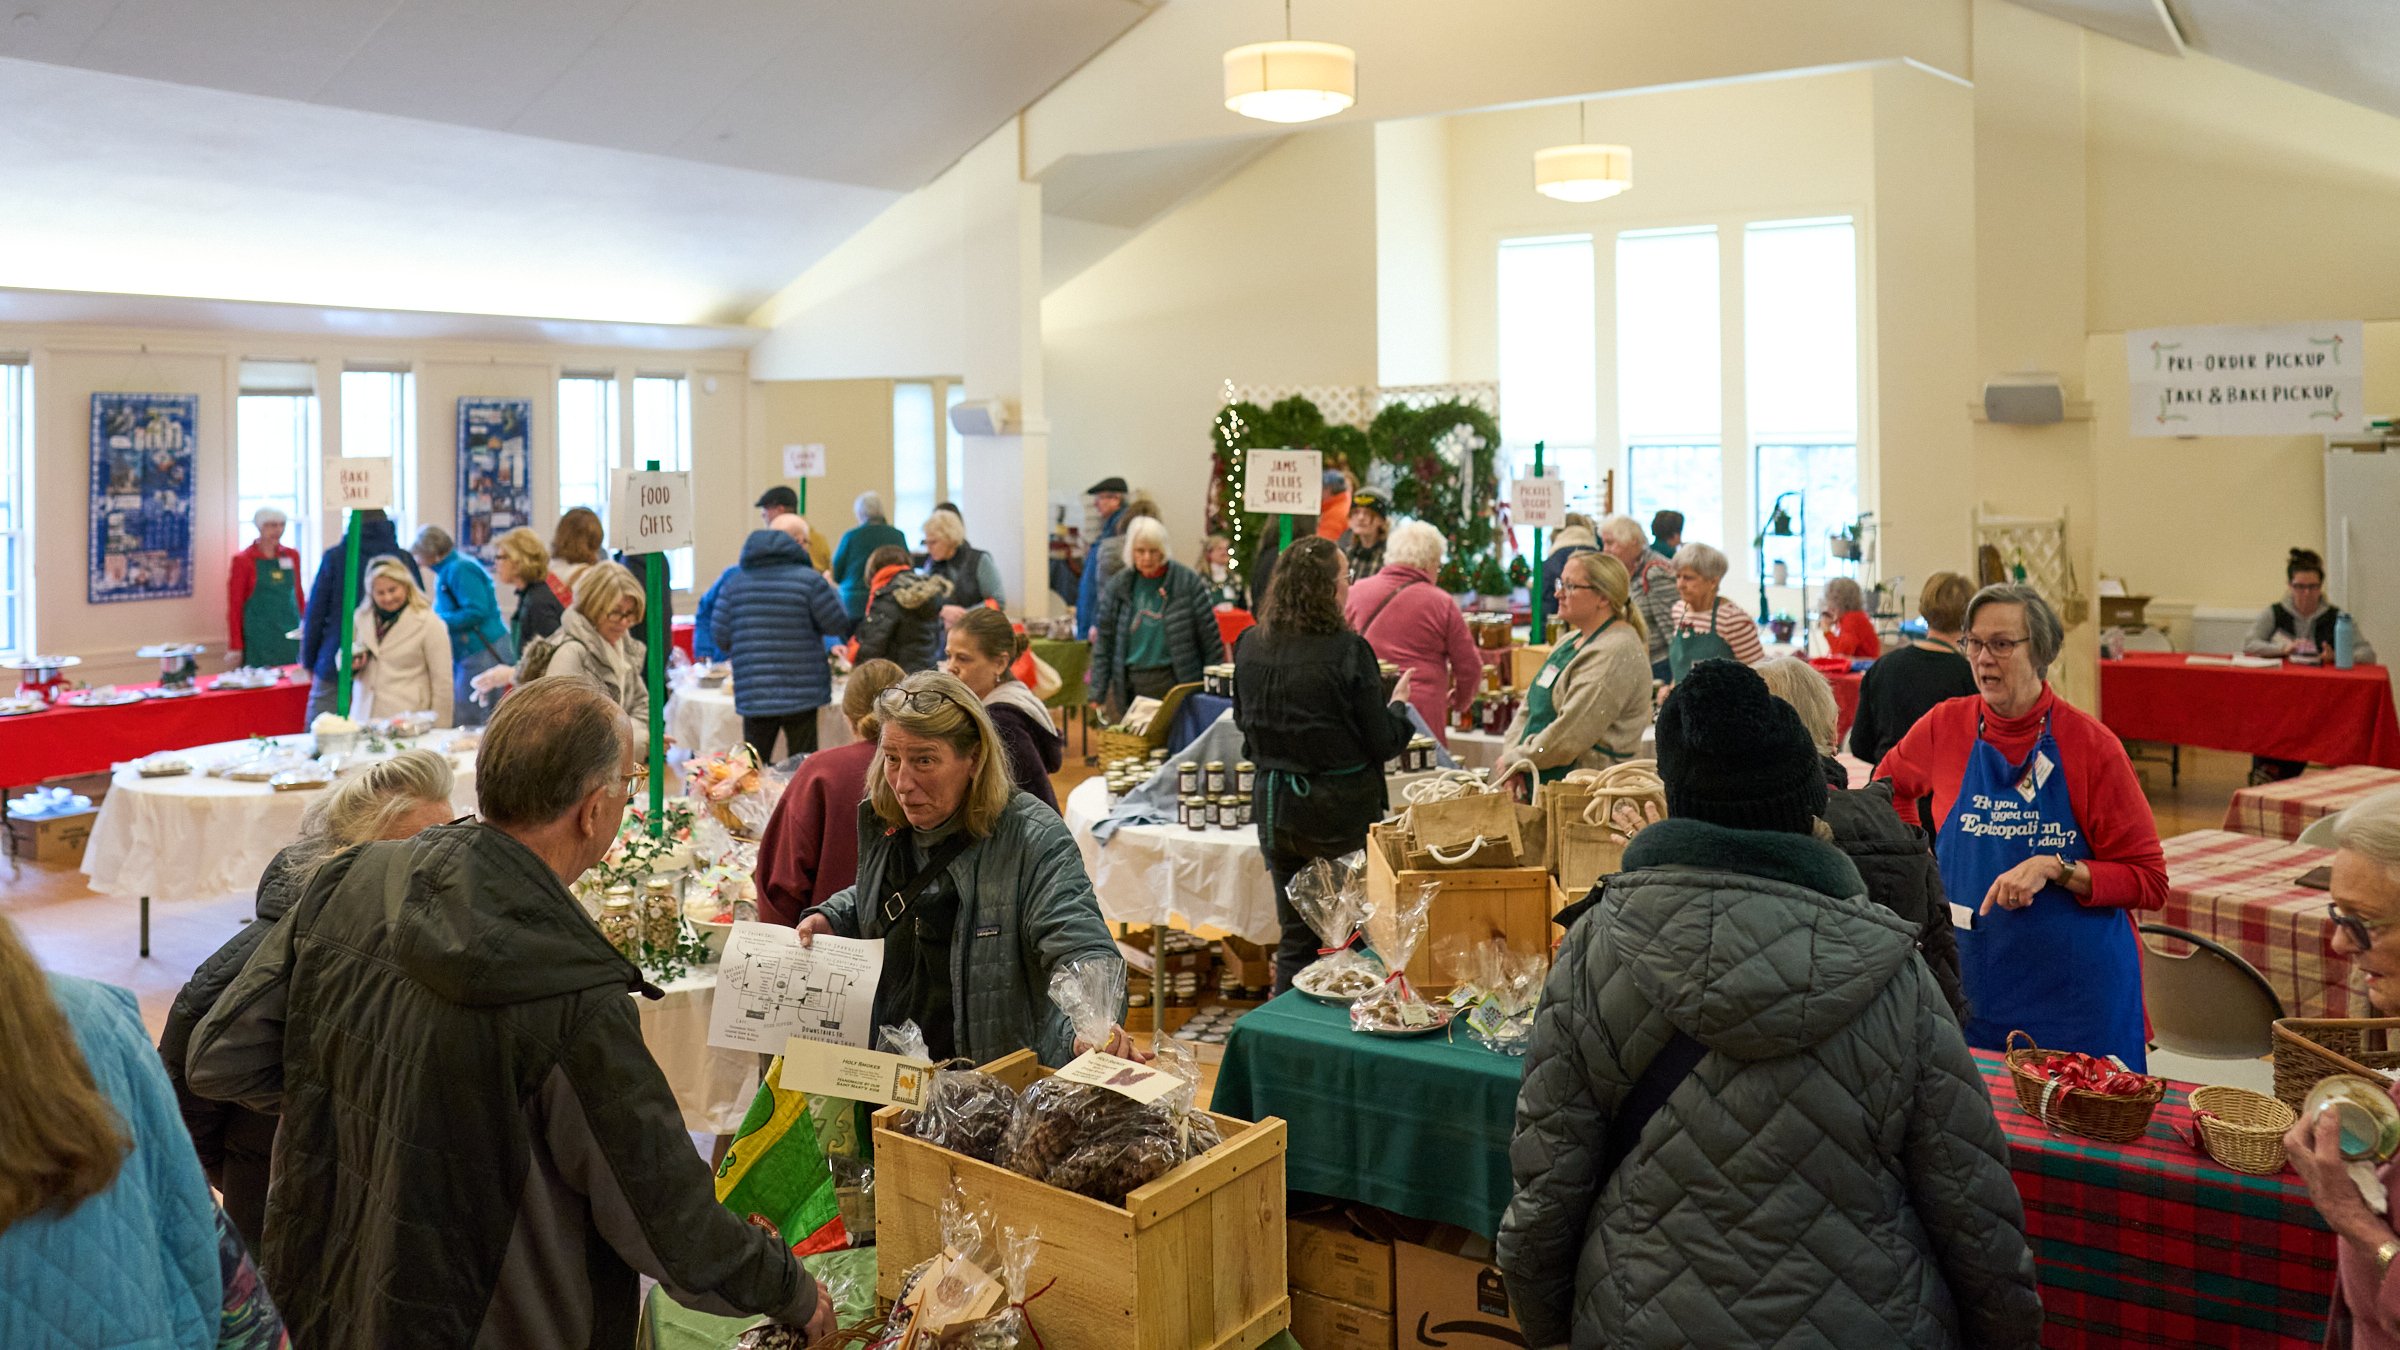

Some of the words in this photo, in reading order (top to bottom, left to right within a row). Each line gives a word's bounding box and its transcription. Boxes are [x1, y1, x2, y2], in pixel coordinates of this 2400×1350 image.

[2168, 354, 2257, 373] PRE-ORDER
[2265, 352, 2326, 370] PICKUP
[2165, 387, 2203, 404] TAKE
[2208, 386, 2222, 405] &
[2226, 386, 2267, 404] BAKE
[2272, 384, 2334, 403] PICKUP
[1270, 460, 1298, 473] JAMS
[340, 469, 369, 485] BAKE
[1265, 475, 1303, 489] JELLIES
[342, 485, 369, 500] SALE
[641, 485, 671, 508] FOOD
[1263, 489, 1303, 504] SAUCES
[640, 514, 673, 538] GIFTS
[1994, 799, 2018, 811] you
[2022, 810, 2040, 820] an
[801, 1025, 836, 1037] DOWNSTAIRS
[842, 1058, 858, 1066] HOLY
[858, 1061, 881, 1070] SMOKES
